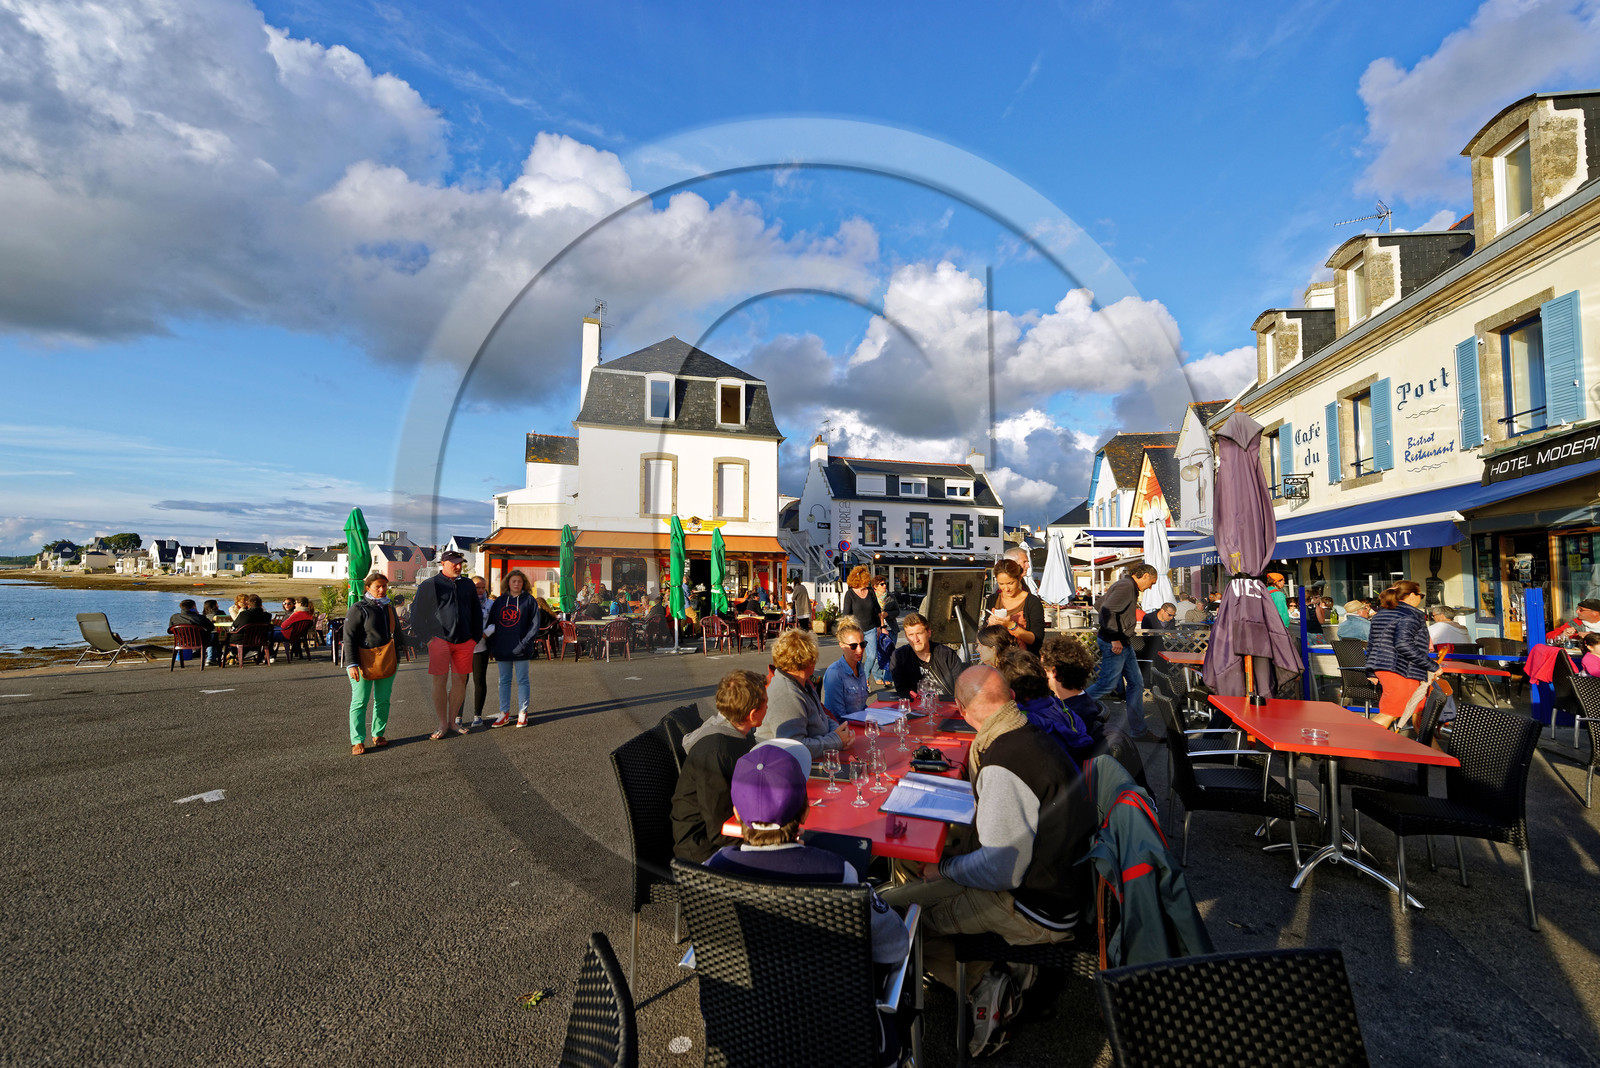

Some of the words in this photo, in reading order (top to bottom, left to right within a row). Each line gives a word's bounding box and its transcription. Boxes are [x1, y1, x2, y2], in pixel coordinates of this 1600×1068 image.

[1396, 367, 1450, 411] Port
[1294, 421, 1320, 446] Café
[1407, 432, 1435, 449] Bistrot
[1304, 448, 1320, 466] du
[1404, 440, 1455, 463] Restaurant
[1490, 454, 1532, 476] HOTEL
[1305, 529, 1412, 555] RESTAURANT
[502, 609, 518, 620] ESB
